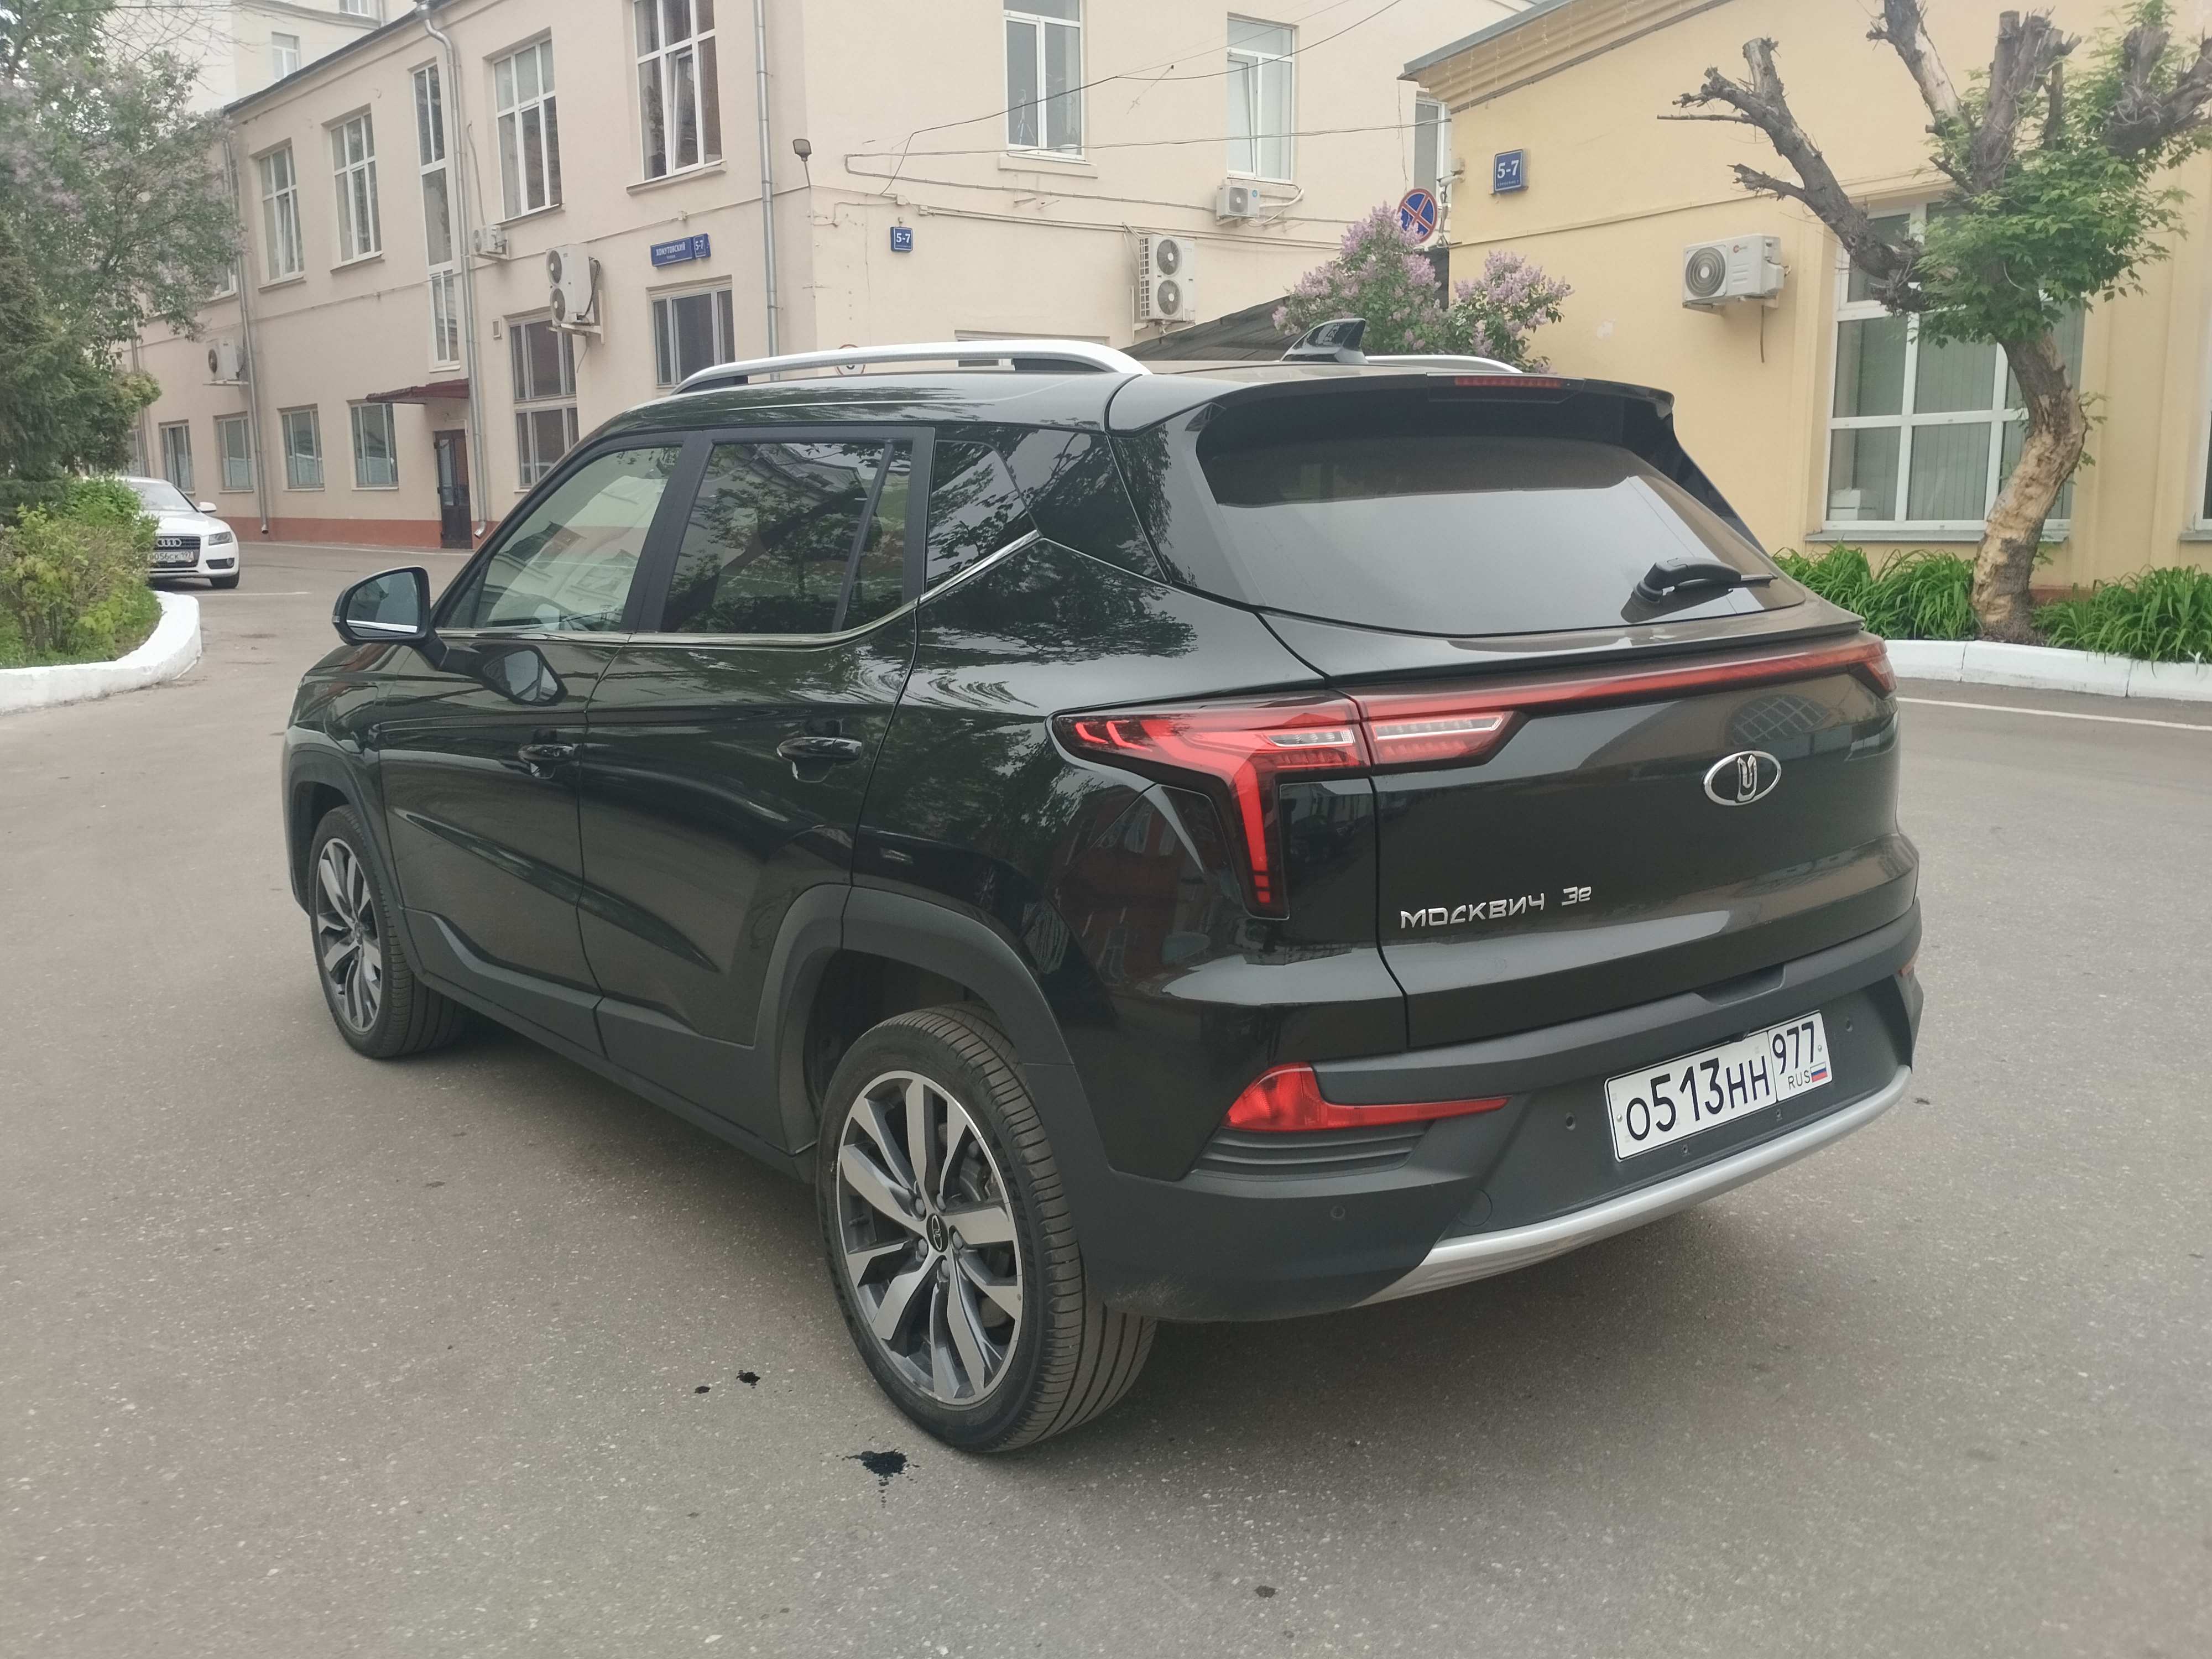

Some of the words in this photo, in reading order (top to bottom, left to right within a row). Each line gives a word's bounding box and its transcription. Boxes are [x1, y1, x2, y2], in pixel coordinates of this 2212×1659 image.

[1497, 160, 1519, 179] 5-7
[695, 240, 703, 251] 5-7
[896, 233, 911, 243] 5-7
[1400, 893, 1545, 928] МОСКВИЧ
[1626, 1056, 1770, 1141] О513НН
[1772, 1021, 1814, 1075] 977
[1788, 1070, 1811, 1091] RUS
